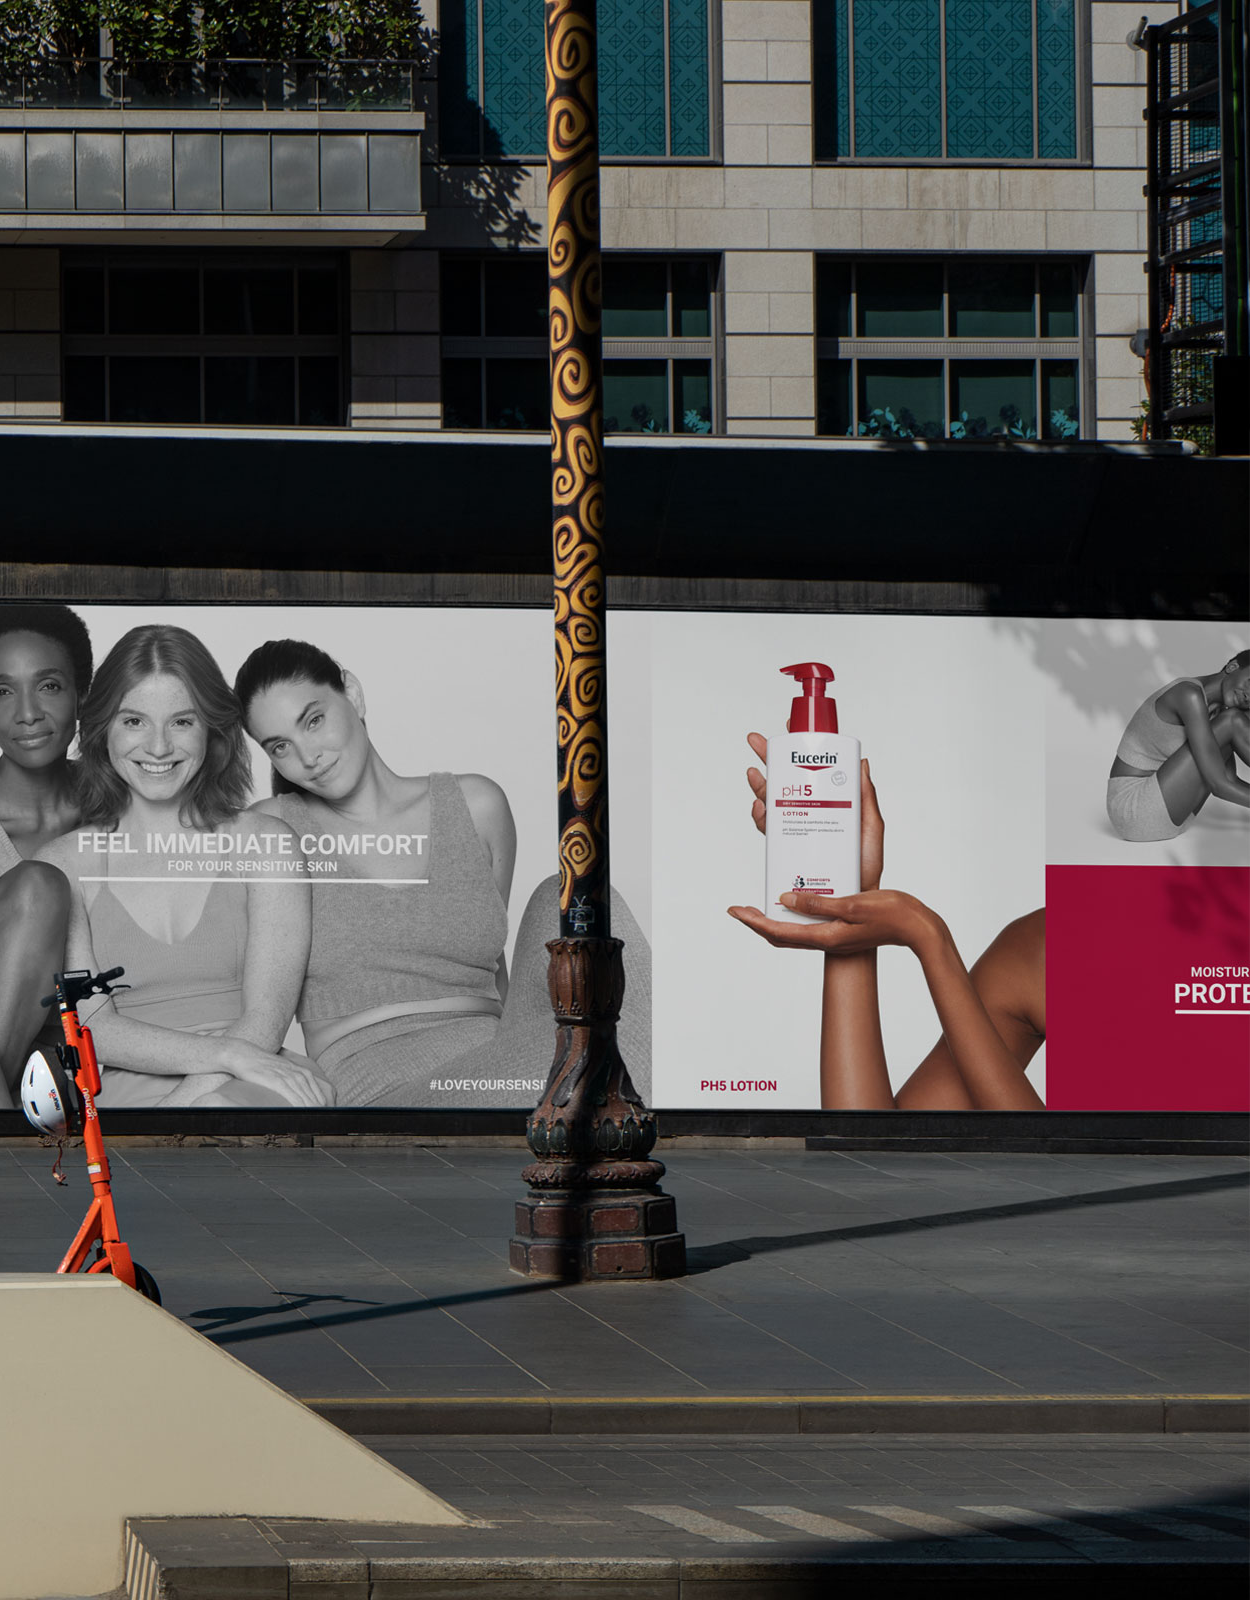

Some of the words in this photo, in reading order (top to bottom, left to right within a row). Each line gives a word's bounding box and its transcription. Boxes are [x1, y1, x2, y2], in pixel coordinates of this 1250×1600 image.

[791, 751, 837, 764] Eucerin
[78, 832, 139, 854] FEEL
[147, 833, 293, 855] IMMEDIATE
[300, 833, 428, 855] COMFORT
[168, 860, 194, 872] FOR
[197, 860, 233, 872] YOUR
[236, 860, 304, 872] SENSITIVE
[307, 861, 338, 873] SKIN
[1191, 966, 1250, 978] MOISTUR
[429, 1079, 547, 1091] #LOVEYOURSENSI
[700, 1080, 727, 1092] PH5
[730, 1080, 777, 1092] LOTION
